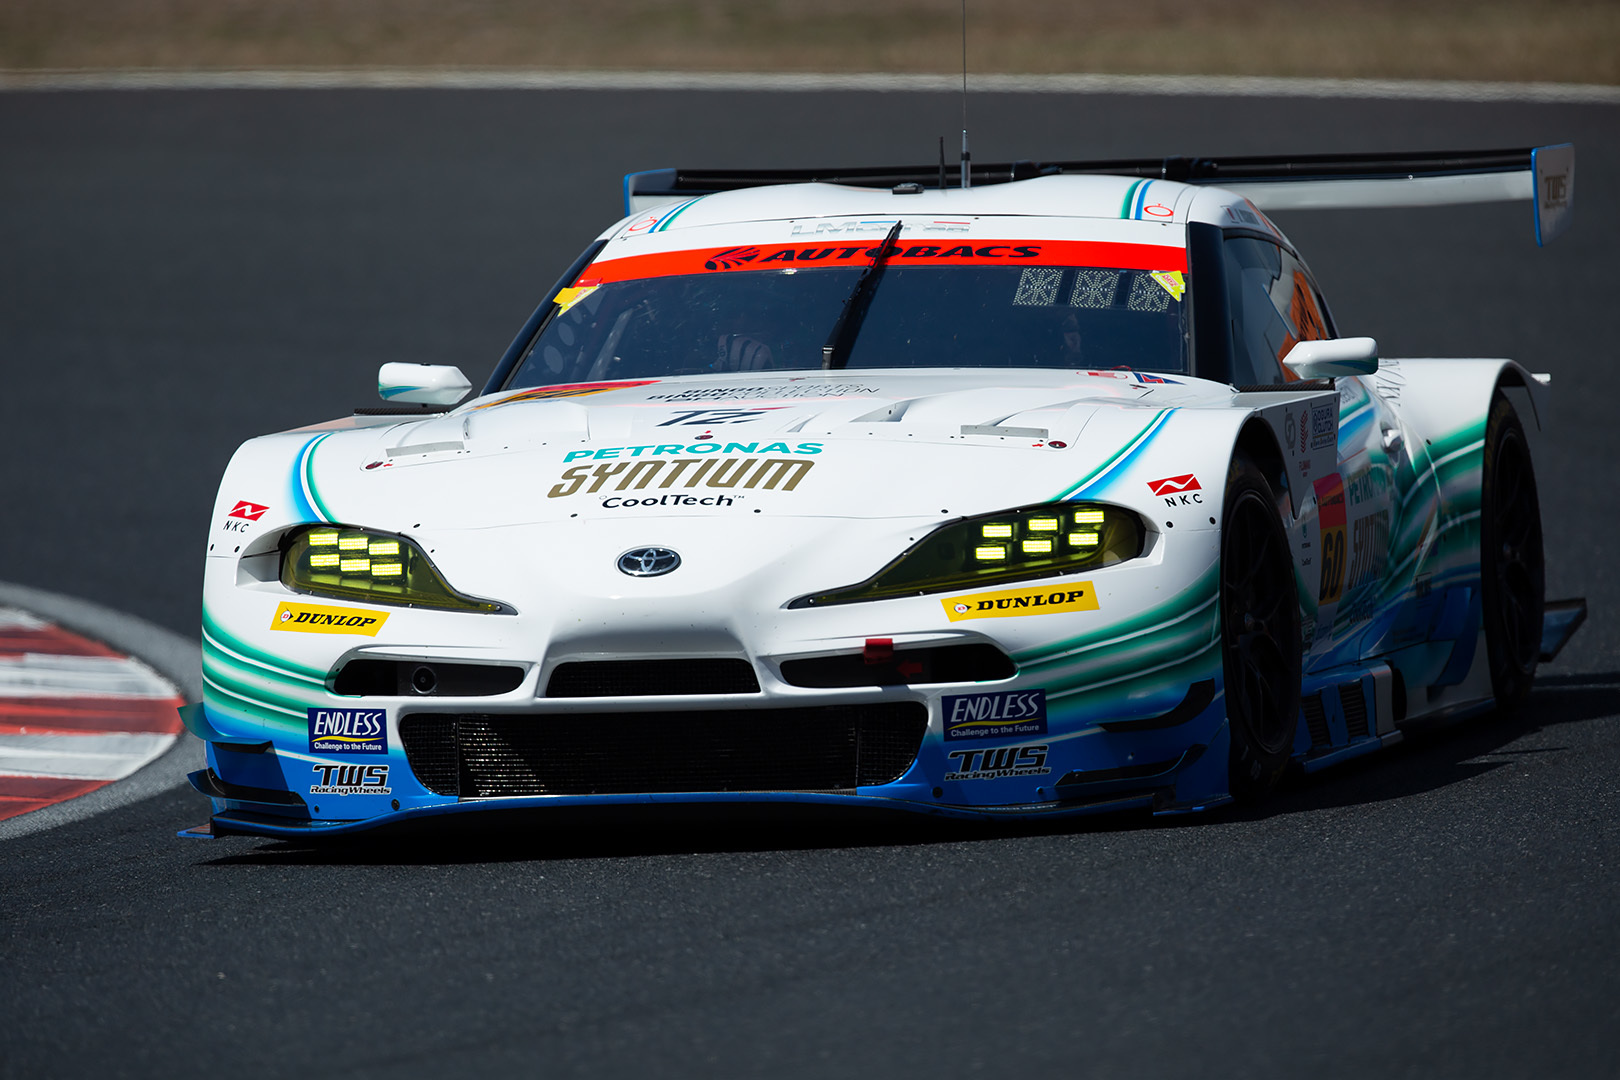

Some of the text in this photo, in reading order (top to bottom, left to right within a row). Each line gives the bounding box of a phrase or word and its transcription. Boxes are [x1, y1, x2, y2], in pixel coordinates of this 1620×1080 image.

[759, 245, 1042, 263] AUTOBACS
[562, 442, 824, 463] PETRONAS
[546, 458, 815, 499] SYNTIUM
[1164, 492, 1203, 508] NKC
[223, 520, 249, 533] NKC
[1319, 530, 1344, 601] 60
[976, 590, 1084, 611] DUNLOP
[293, 612, 377, 627] DUNLOP
[950, 692, 1040, 723] ENDLESS
[313, 711, 382, 736] ENDLESS
[950, 724, 1040, 738] Challenge to the Future
[314, 741, 343, 751] Challenge
[350, 742, 361, 750] the
[361, 742, 382, 751] Future
[948, 744, 1050, 772] TWS
[313, 764, 390, 787] TWS
